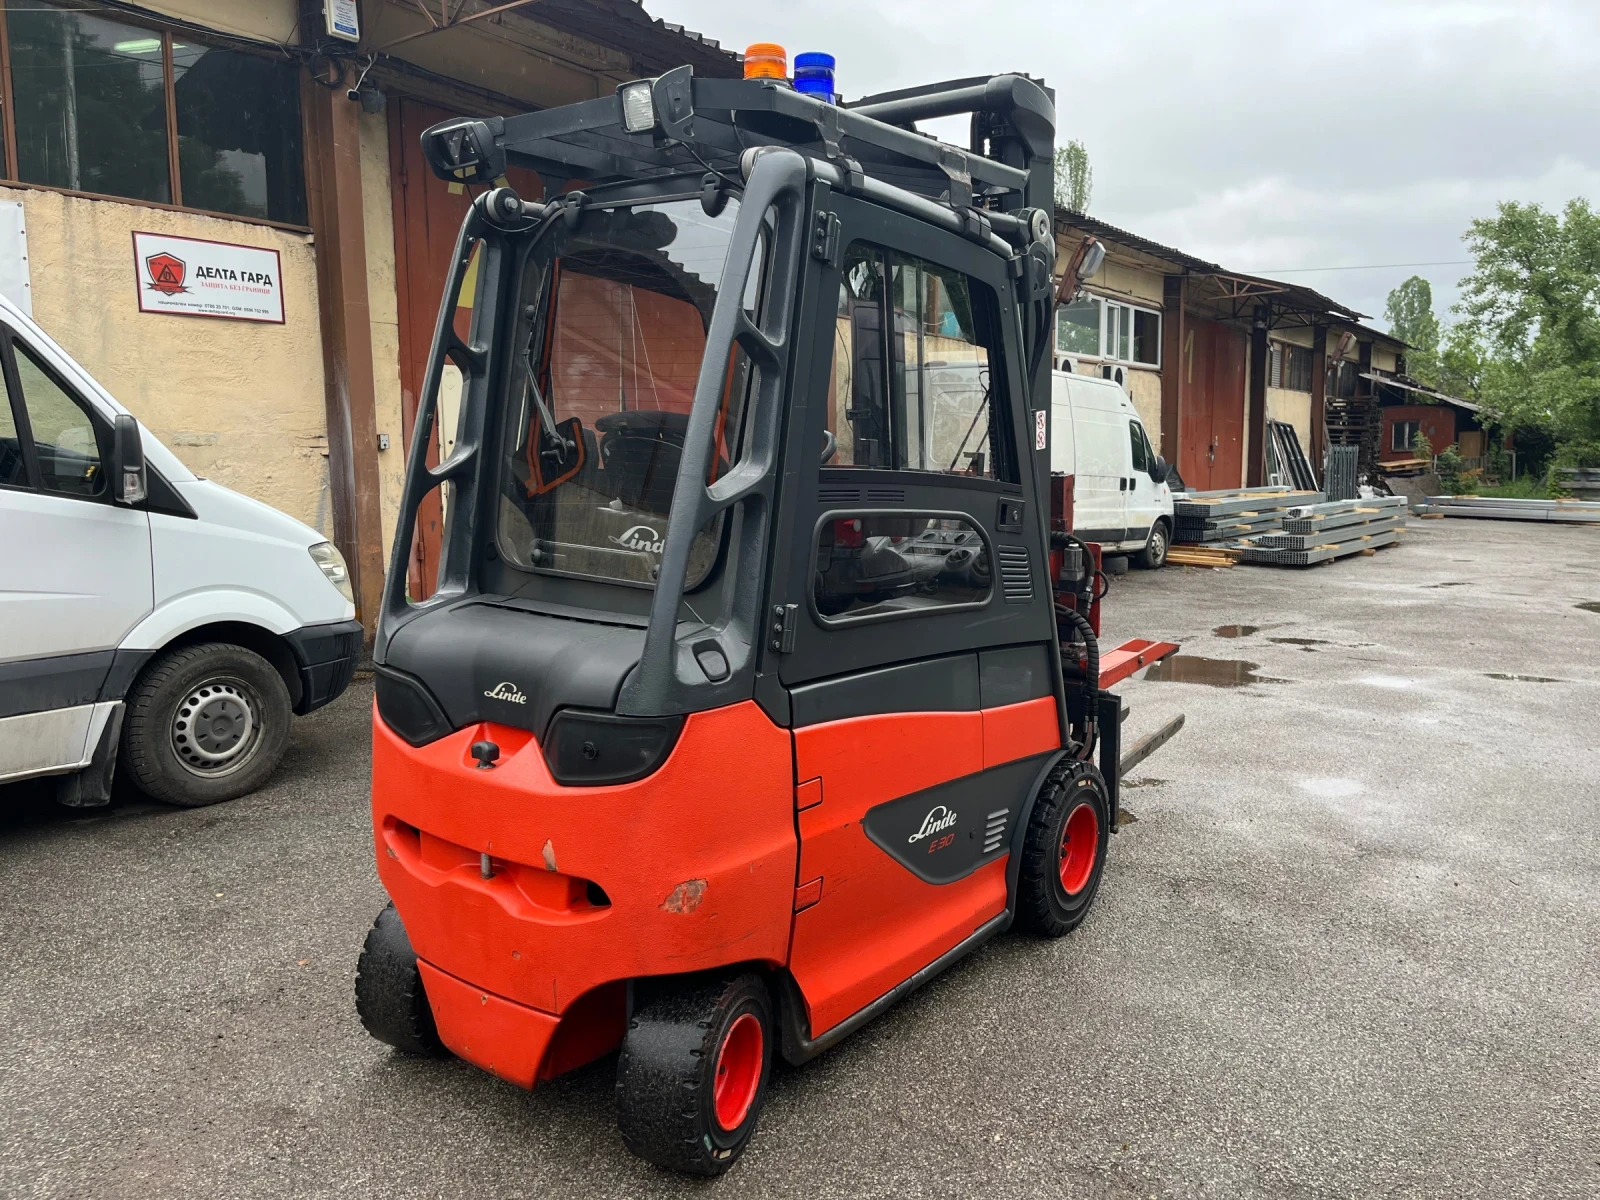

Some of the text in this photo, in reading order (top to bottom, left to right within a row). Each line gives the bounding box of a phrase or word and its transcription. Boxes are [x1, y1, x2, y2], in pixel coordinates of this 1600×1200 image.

[196, 266, 273, 287] ДЕЛТА ГАРД
[201, 281, 271, 295] ЗАЩИТА БЕЗ ГРАНИЦИ
[608, 525, 666, 554] Lind
[483, 681, 527, 705] Linde
[908, 805, 957, 844] Linde
[928, 833, 955, 854] E30
